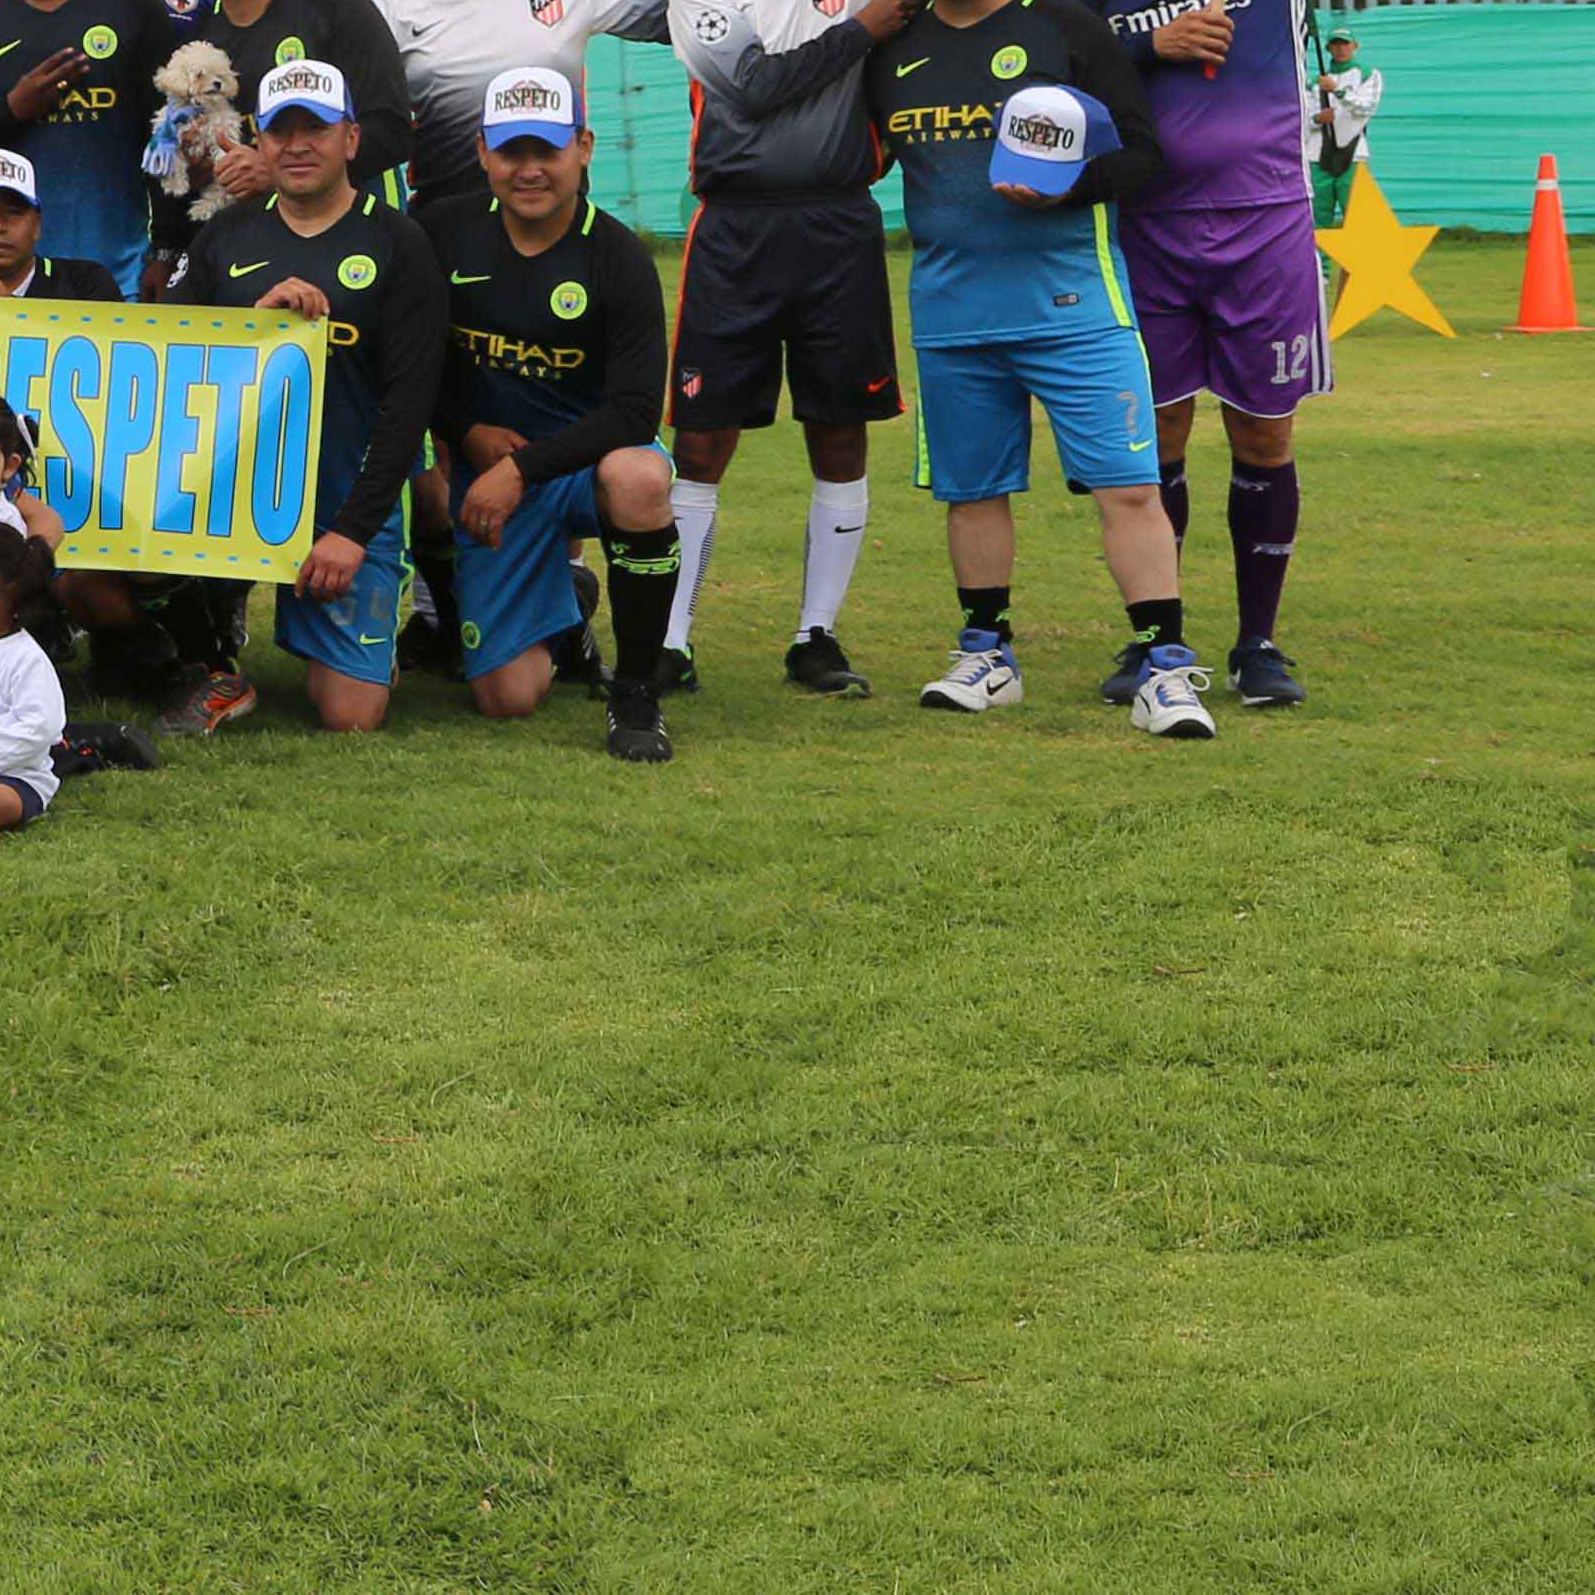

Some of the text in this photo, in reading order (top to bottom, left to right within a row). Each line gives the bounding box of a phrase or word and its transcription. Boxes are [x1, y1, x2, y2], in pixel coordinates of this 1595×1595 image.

[268, 71, 332, 96] RESPETO
[494, 88, 561, 112] RESPETO
[888, 102, 1003, 133] ETIHA
[1008, 115, 1075, 150] RESPETO
[906, 126, 992, 144] AIRWAY
[451, 326, 586, 369] TIHAD
[1270, 334, 1308, 385] 12
